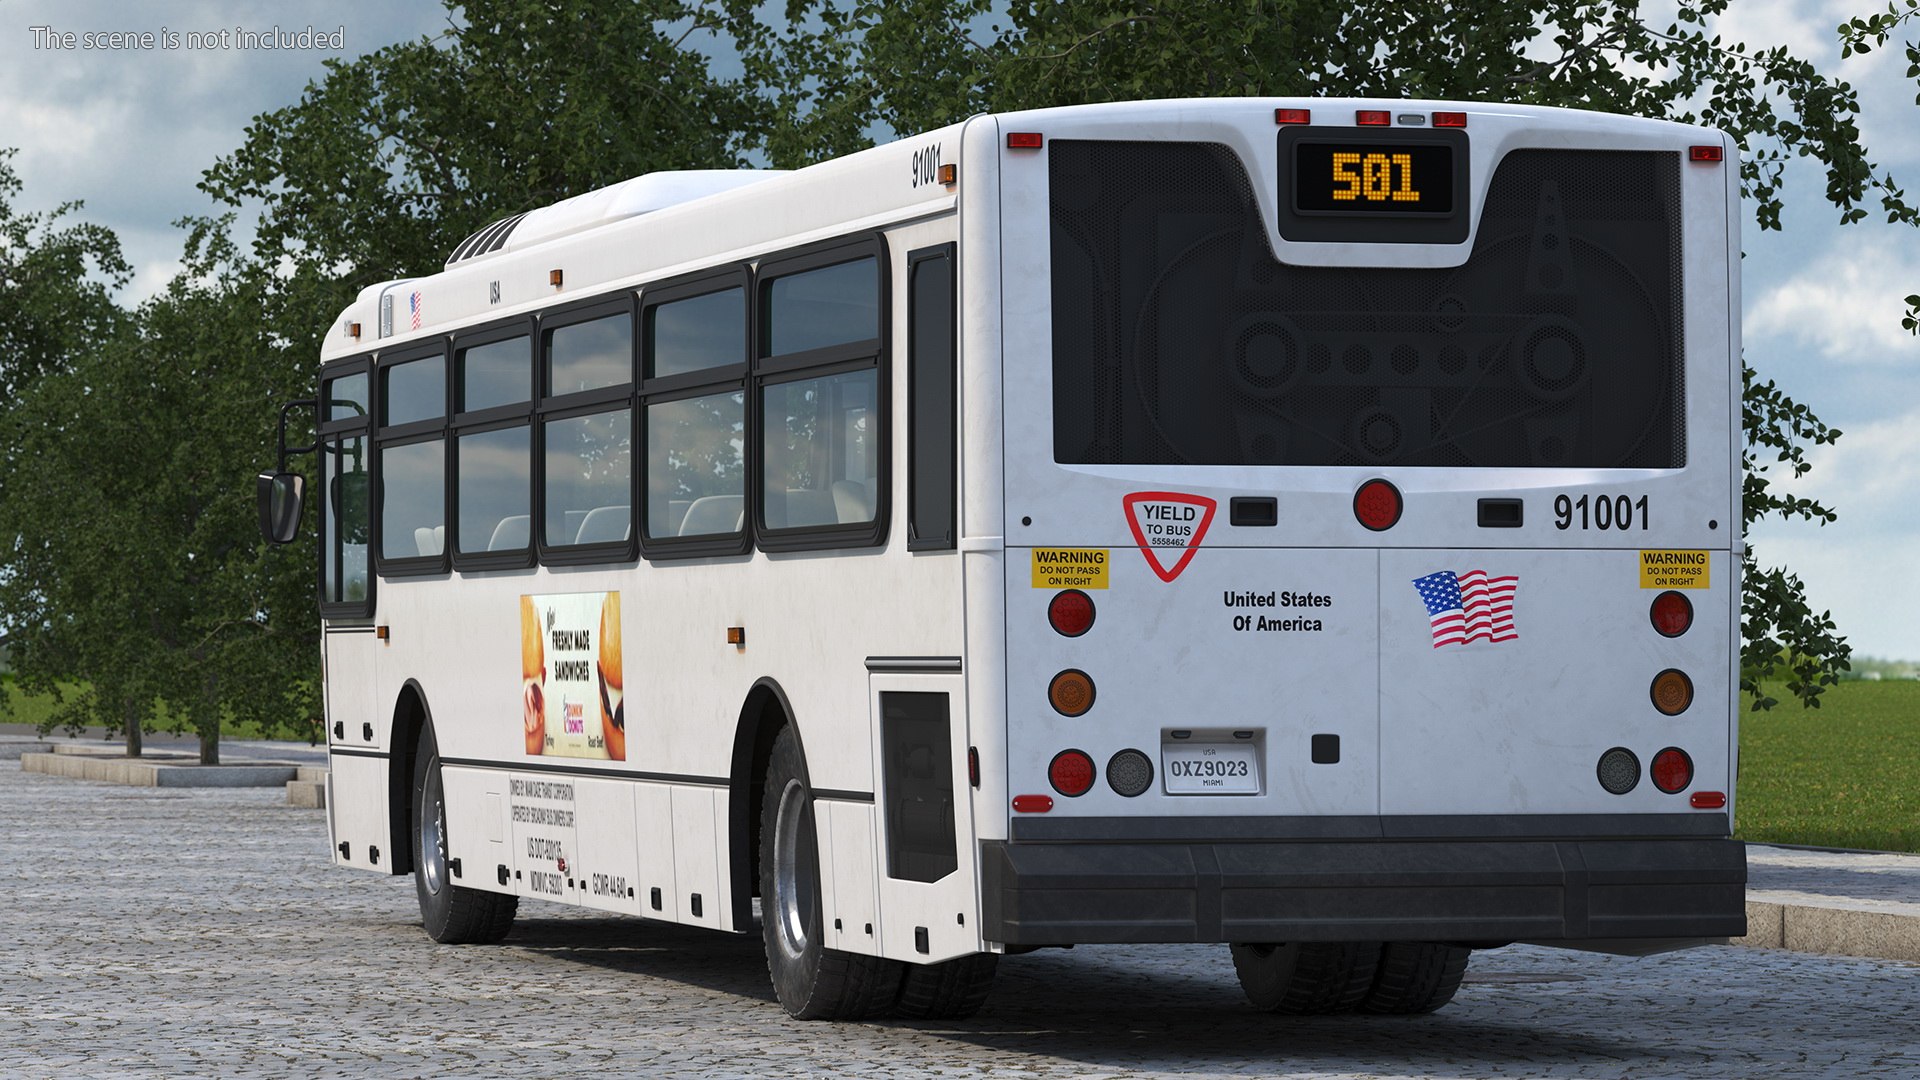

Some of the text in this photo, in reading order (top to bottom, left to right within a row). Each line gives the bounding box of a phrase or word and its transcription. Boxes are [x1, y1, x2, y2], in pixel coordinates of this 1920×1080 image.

[912, 141, 941, 189] 91001
[1333, 152, 1420, 202] 501
[490, 280, 501, 305] USA
[1143, 504, 1196, 522] YIELD
[1554, 494, 1648, 531] 91001
[1147, 524, 1191, 536] TO BUS
[1152, 537, 1185, 547] 5558462
[1036, 552, 1105, 564] WARNING
[1643, 553, 1706, 565] WARNING
[1040, 566, 1100, 576] DO NOT PASS
[1647, 567, 1702, 575] DO NOT PASS
[1048, 577, 1092, 586] ON RIGHT
[1655, 577, 1695, 586] ON RIGHT
[1224, 591, 1332, 607] United States
[1233, 615, 1322, 632] Of America
[552, 629, 590, 651] FRESHLY MADE
[555, 660, 590, 682] SANDWICHES
[568, 719, 584, 734] DONUTS
[527, 836, 534, 858] US
[592, 872, 610, 896] GCWR
